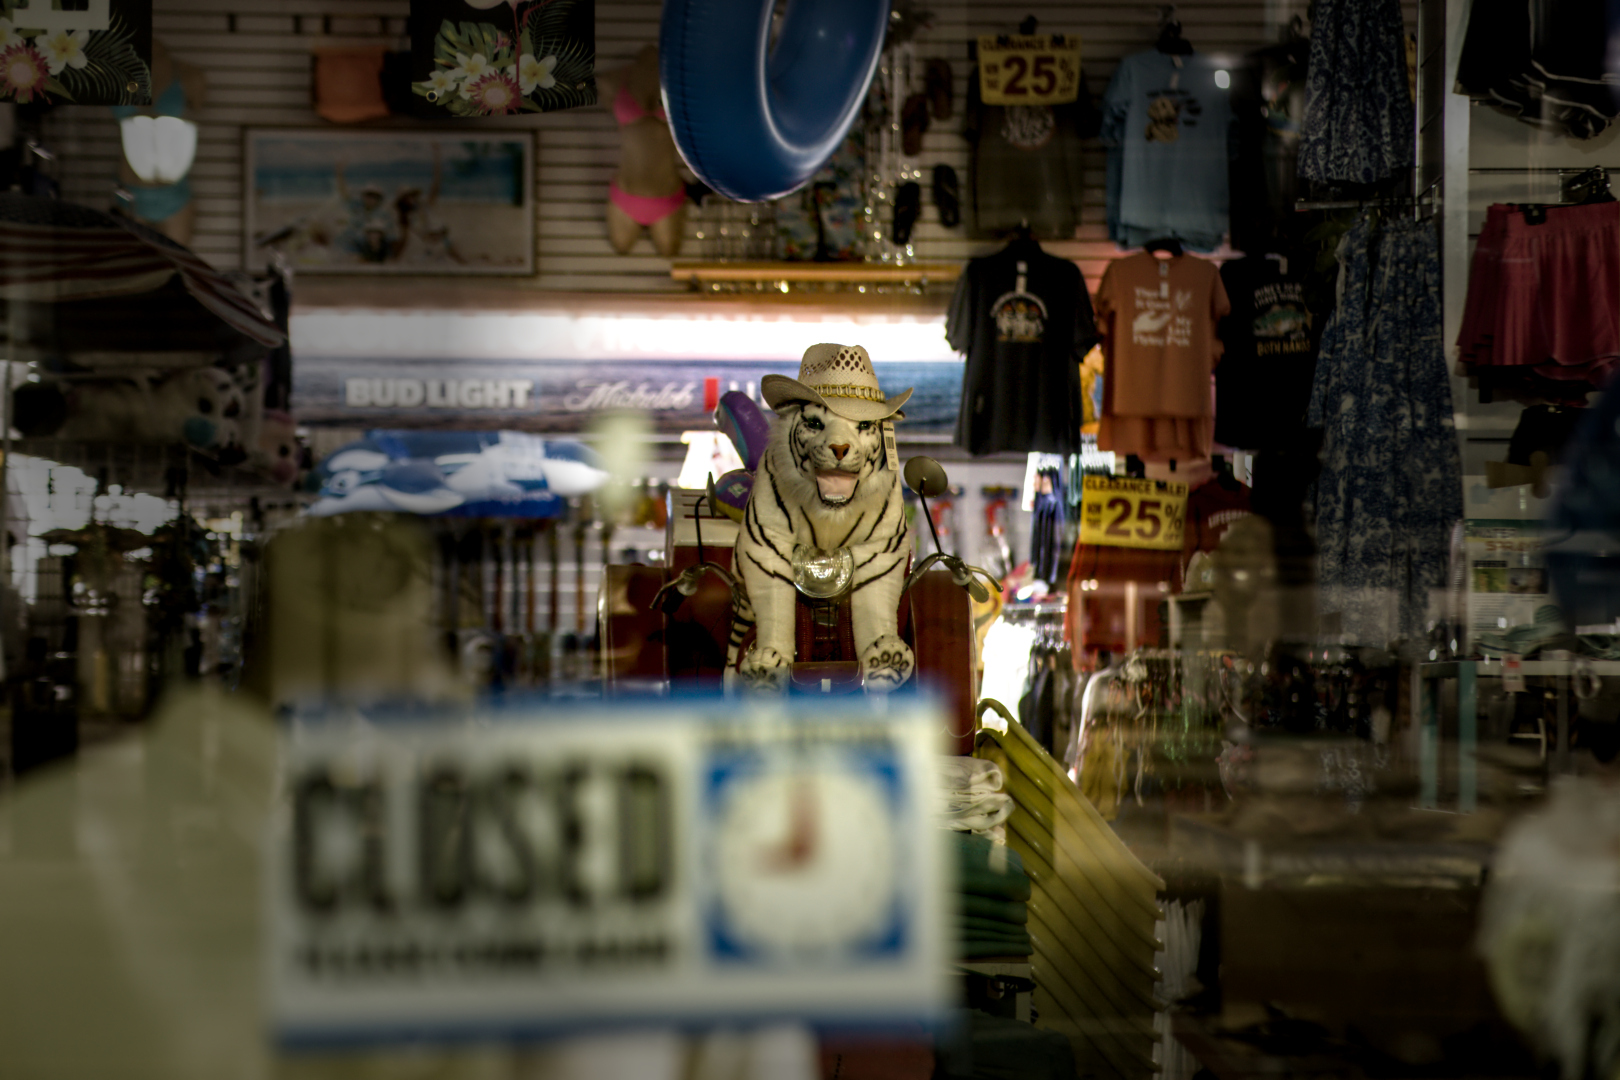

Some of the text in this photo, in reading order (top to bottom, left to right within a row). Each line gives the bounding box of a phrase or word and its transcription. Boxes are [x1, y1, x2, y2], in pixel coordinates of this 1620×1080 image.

[1256, 340, 1281, 357] BOTH
[345, 379, 426, 409] BUD
[426, 379, 534, 409] LIGHT
[1084, 479, 1152, 496] CLEARANCE
[1208, 509, 1250, 529] LIFEGUAR
[293, 764, 674, 910] CLOSED
